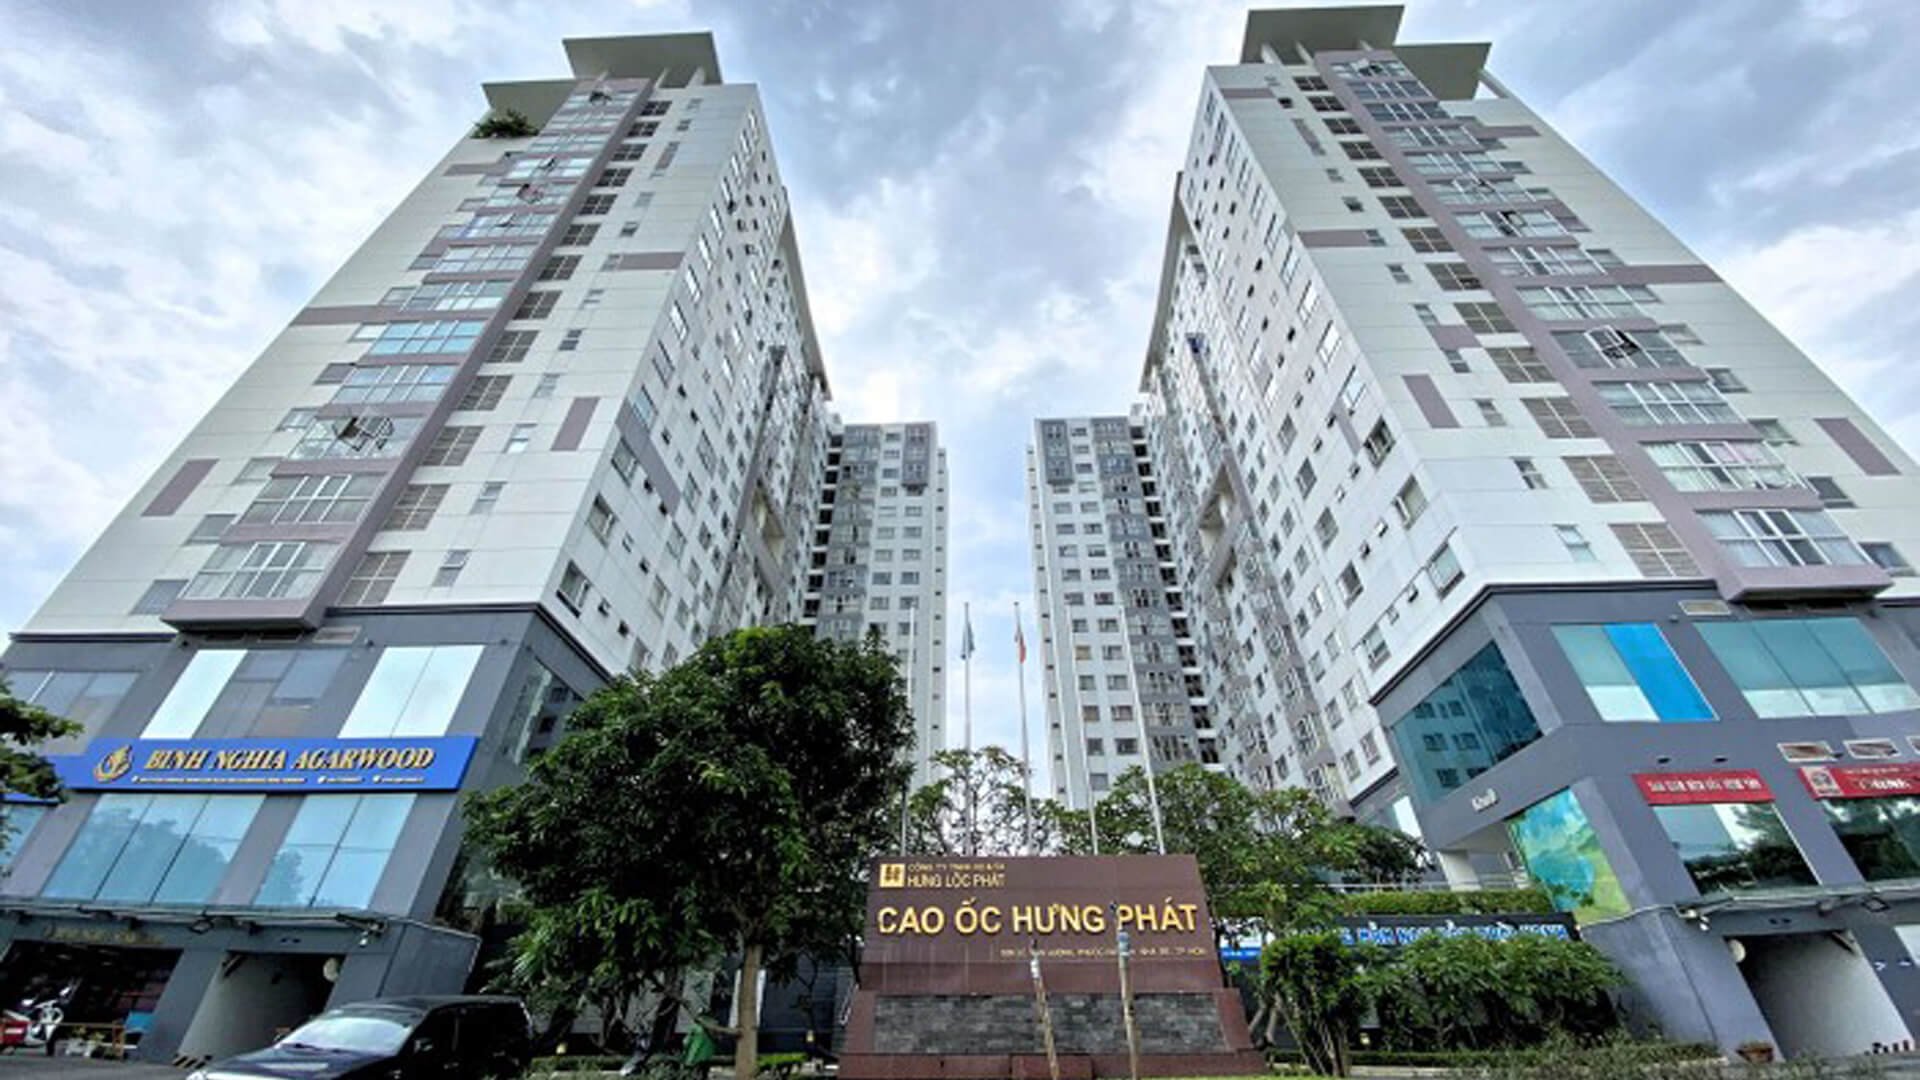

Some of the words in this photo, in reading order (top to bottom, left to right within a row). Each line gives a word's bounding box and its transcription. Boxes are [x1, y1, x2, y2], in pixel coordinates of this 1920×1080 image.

[291, 747, 438, 770] AGARWOOD
[878, 905, 946, 935] CAO
[954, 896, 1002, 935] ỐC
[1011, 903, 1106, 934] HƯNG
[1115, 896, 1198, 933] PHÁT
